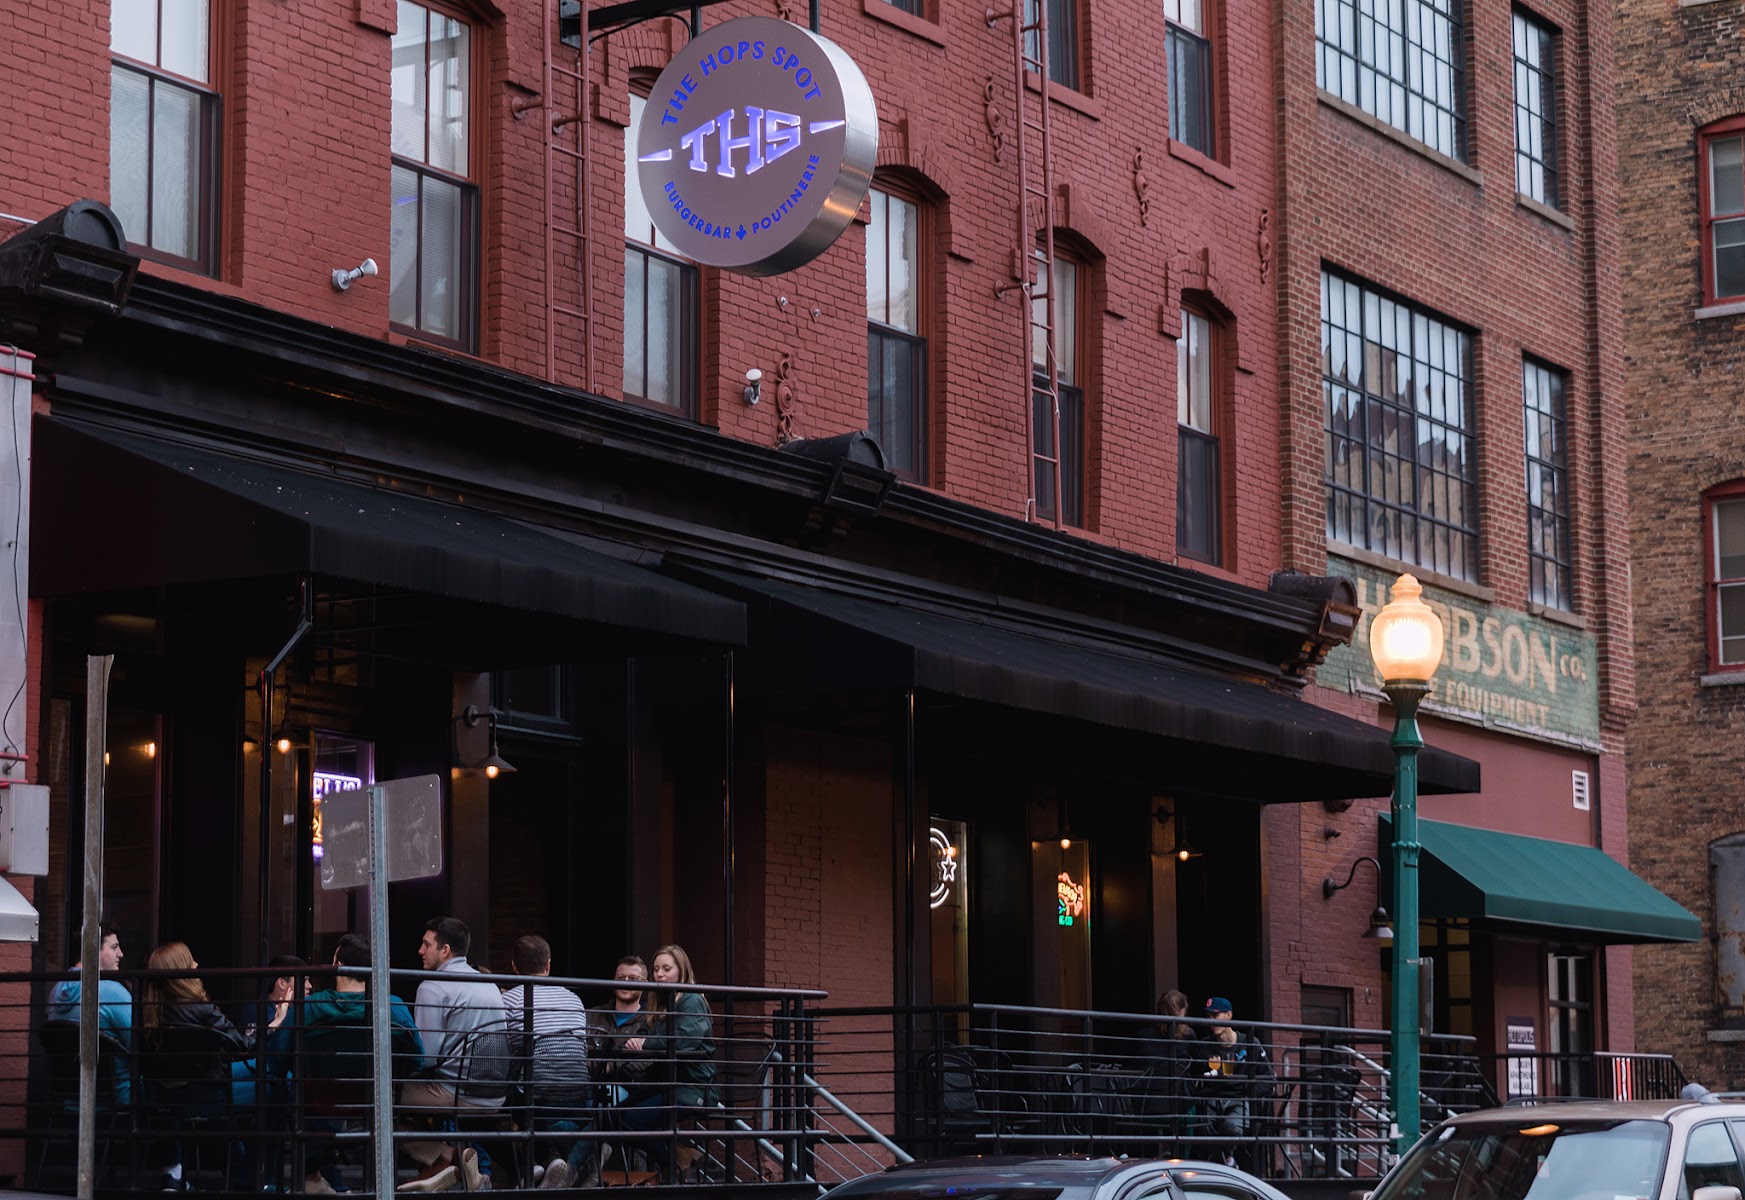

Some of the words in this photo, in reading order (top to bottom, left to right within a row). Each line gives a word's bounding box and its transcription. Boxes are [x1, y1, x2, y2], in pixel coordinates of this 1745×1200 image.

[661, 73, 698, 127] THE
[700, 41, 765, 76] HOPS
[772, 46, 821, 101] SPOT
[680, 105, 801, 178] THS
[664, 181, 731, 240] BURGERBAR
[752, 154, 820, 234] POUTINERIE
[1446, 679, 1549, 728] EQUIPMENT
[1510, 1070, 1536, 1080] APATMENS
